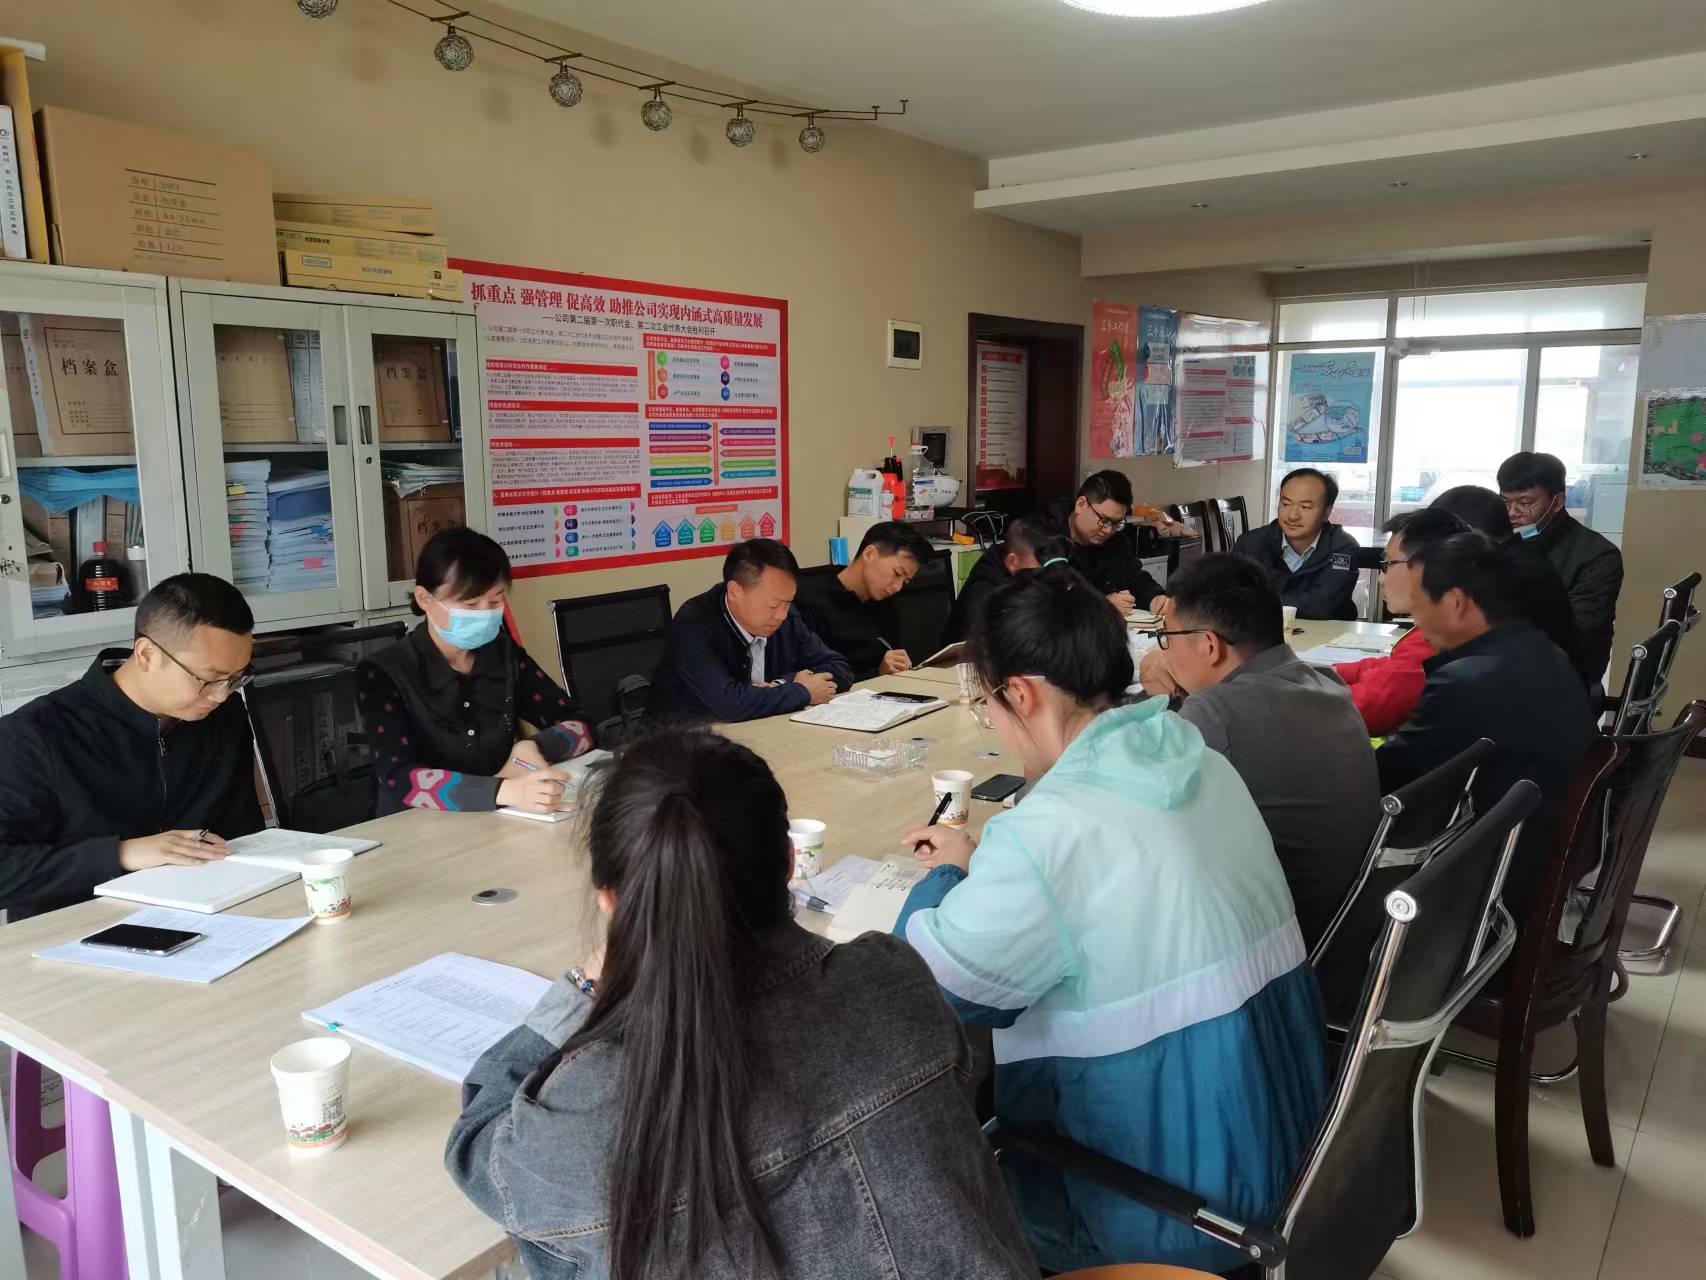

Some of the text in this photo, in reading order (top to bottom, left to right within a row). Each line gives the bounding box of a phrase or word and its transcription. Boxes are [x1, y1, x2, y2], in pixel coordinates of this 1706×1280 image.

[470, 282, 763, 328] 抓重点 强管理 促高效 助推公司实现内涵式高质量发展
[62, 357, 119, 376] 档案盒
